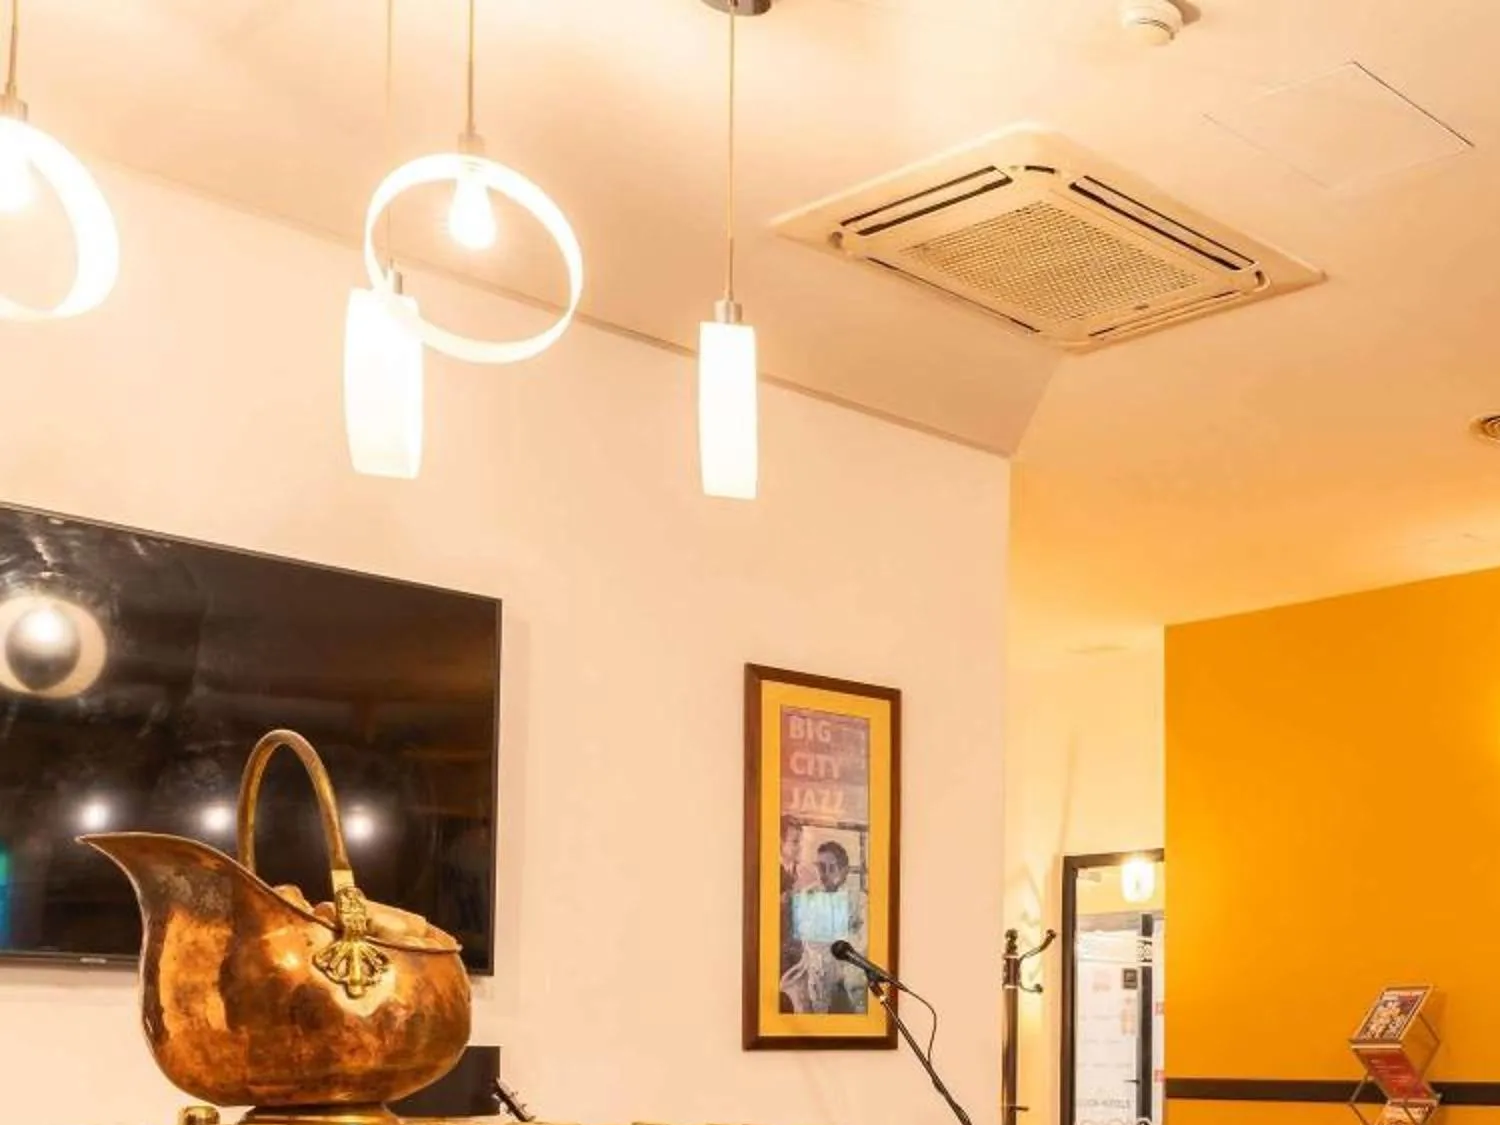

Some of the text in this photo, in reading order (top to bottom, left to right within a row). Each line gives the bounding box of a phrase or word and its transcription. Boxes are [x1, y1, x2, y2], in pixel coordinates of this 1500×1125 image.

[788, 716, 832, 743] BIG
[789, 751, 842, 779] CITY
[788, 786, 846, 817] JAZZ
